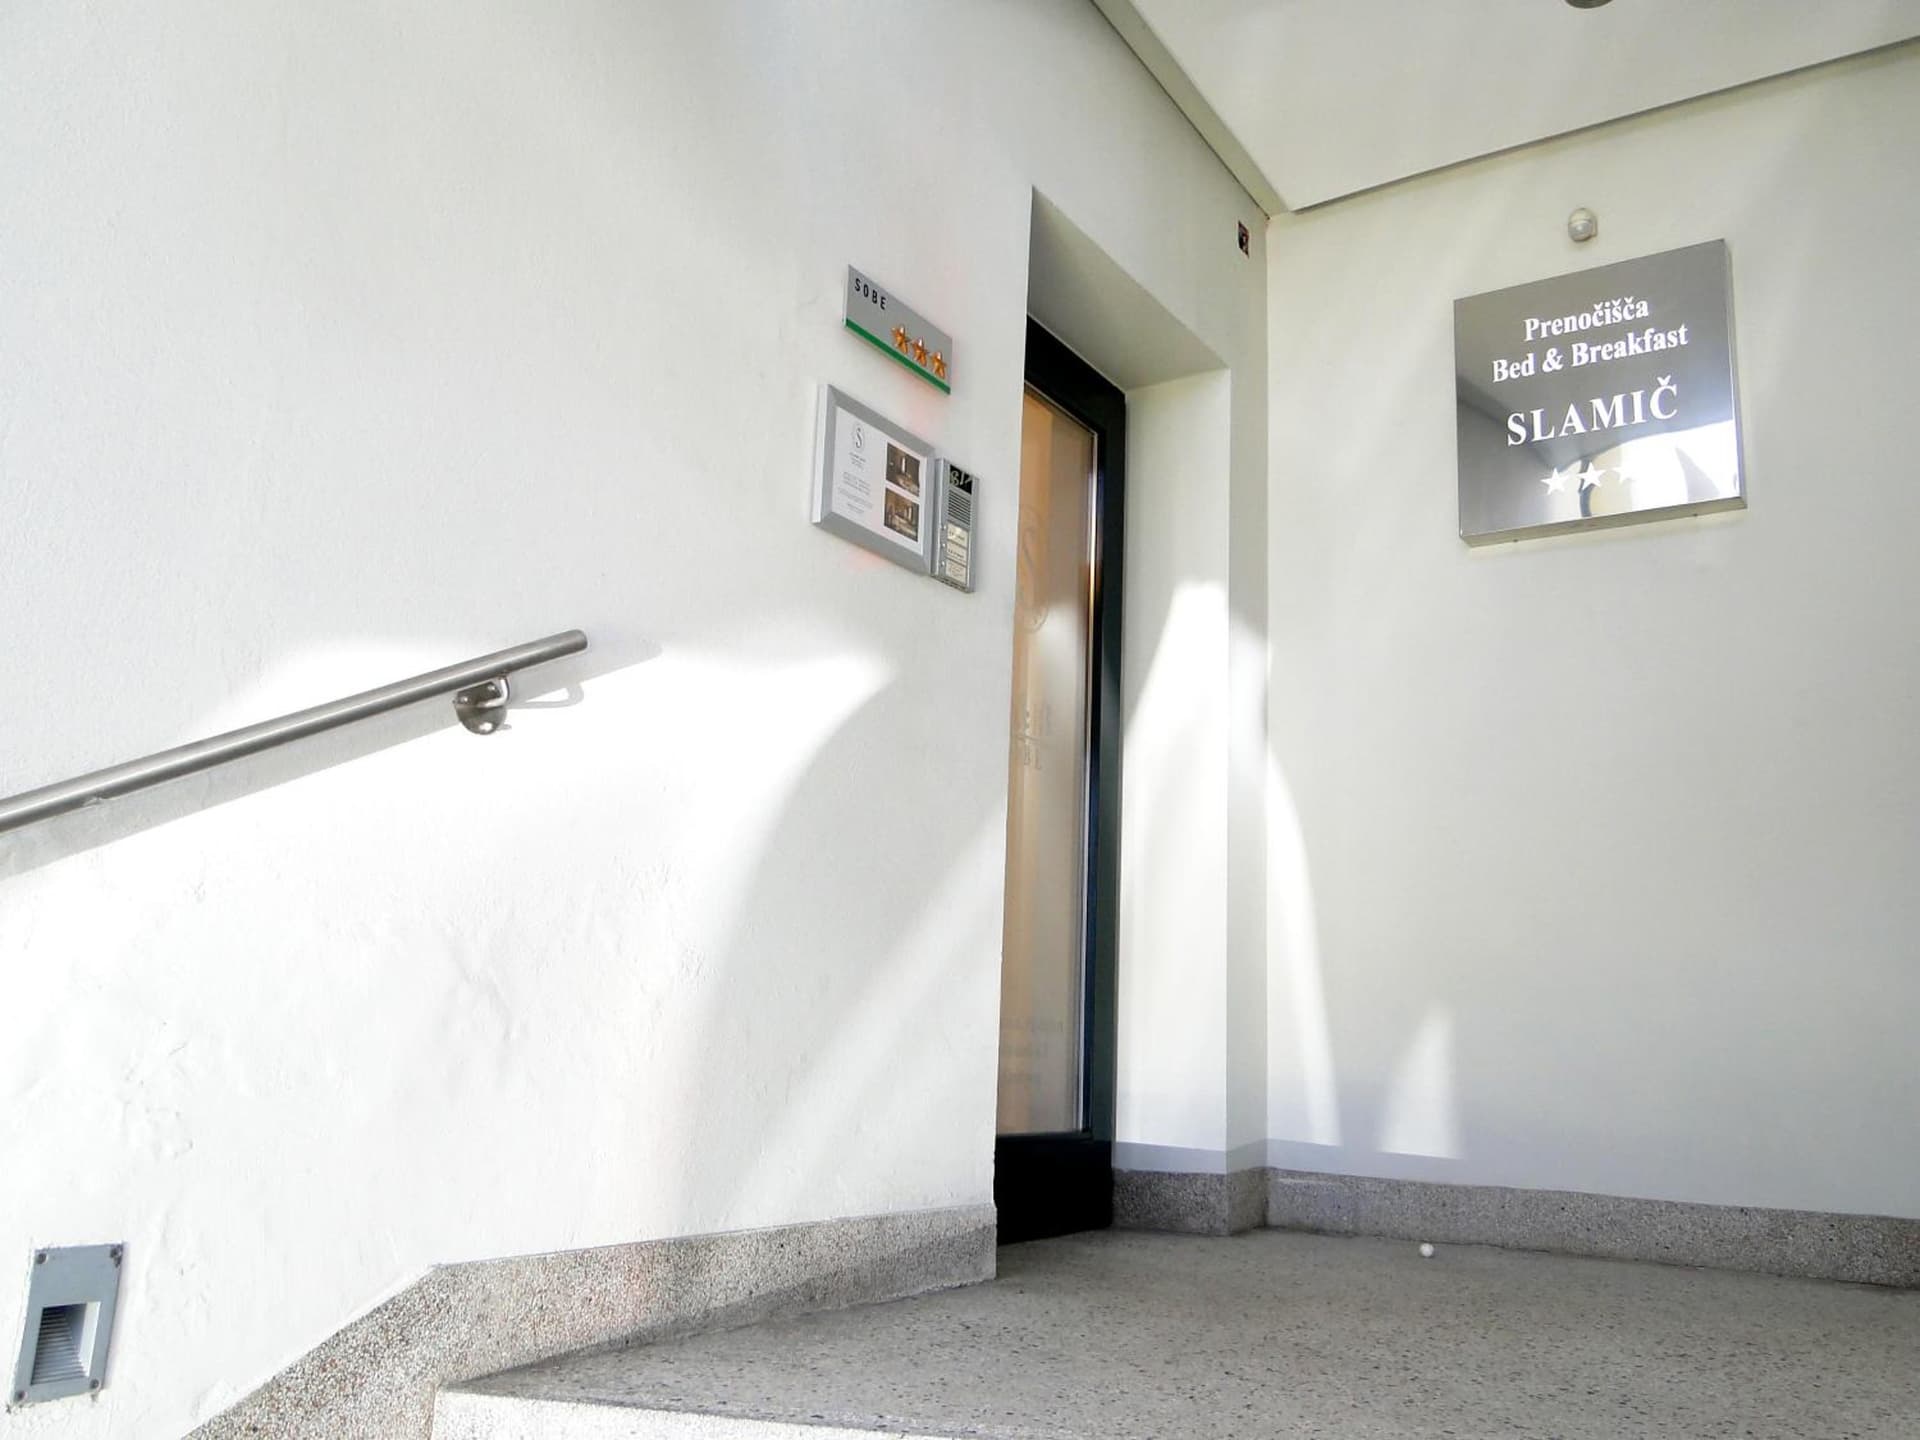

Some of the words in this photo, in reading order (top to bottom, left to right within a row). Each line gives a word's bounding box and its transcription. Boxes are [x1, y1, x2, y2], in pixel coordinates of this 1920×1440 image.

[854, 278, 887, 310] SOBE
[1523, 296, 1649, 341] Prenočišča
[1492, 353, 1536, 382] Bed
[1541, 347, 1564, 373] &
[1571, 323, 1689, 367] Breakfast
[1506, 375, 1678, 446] SLAMIČ
